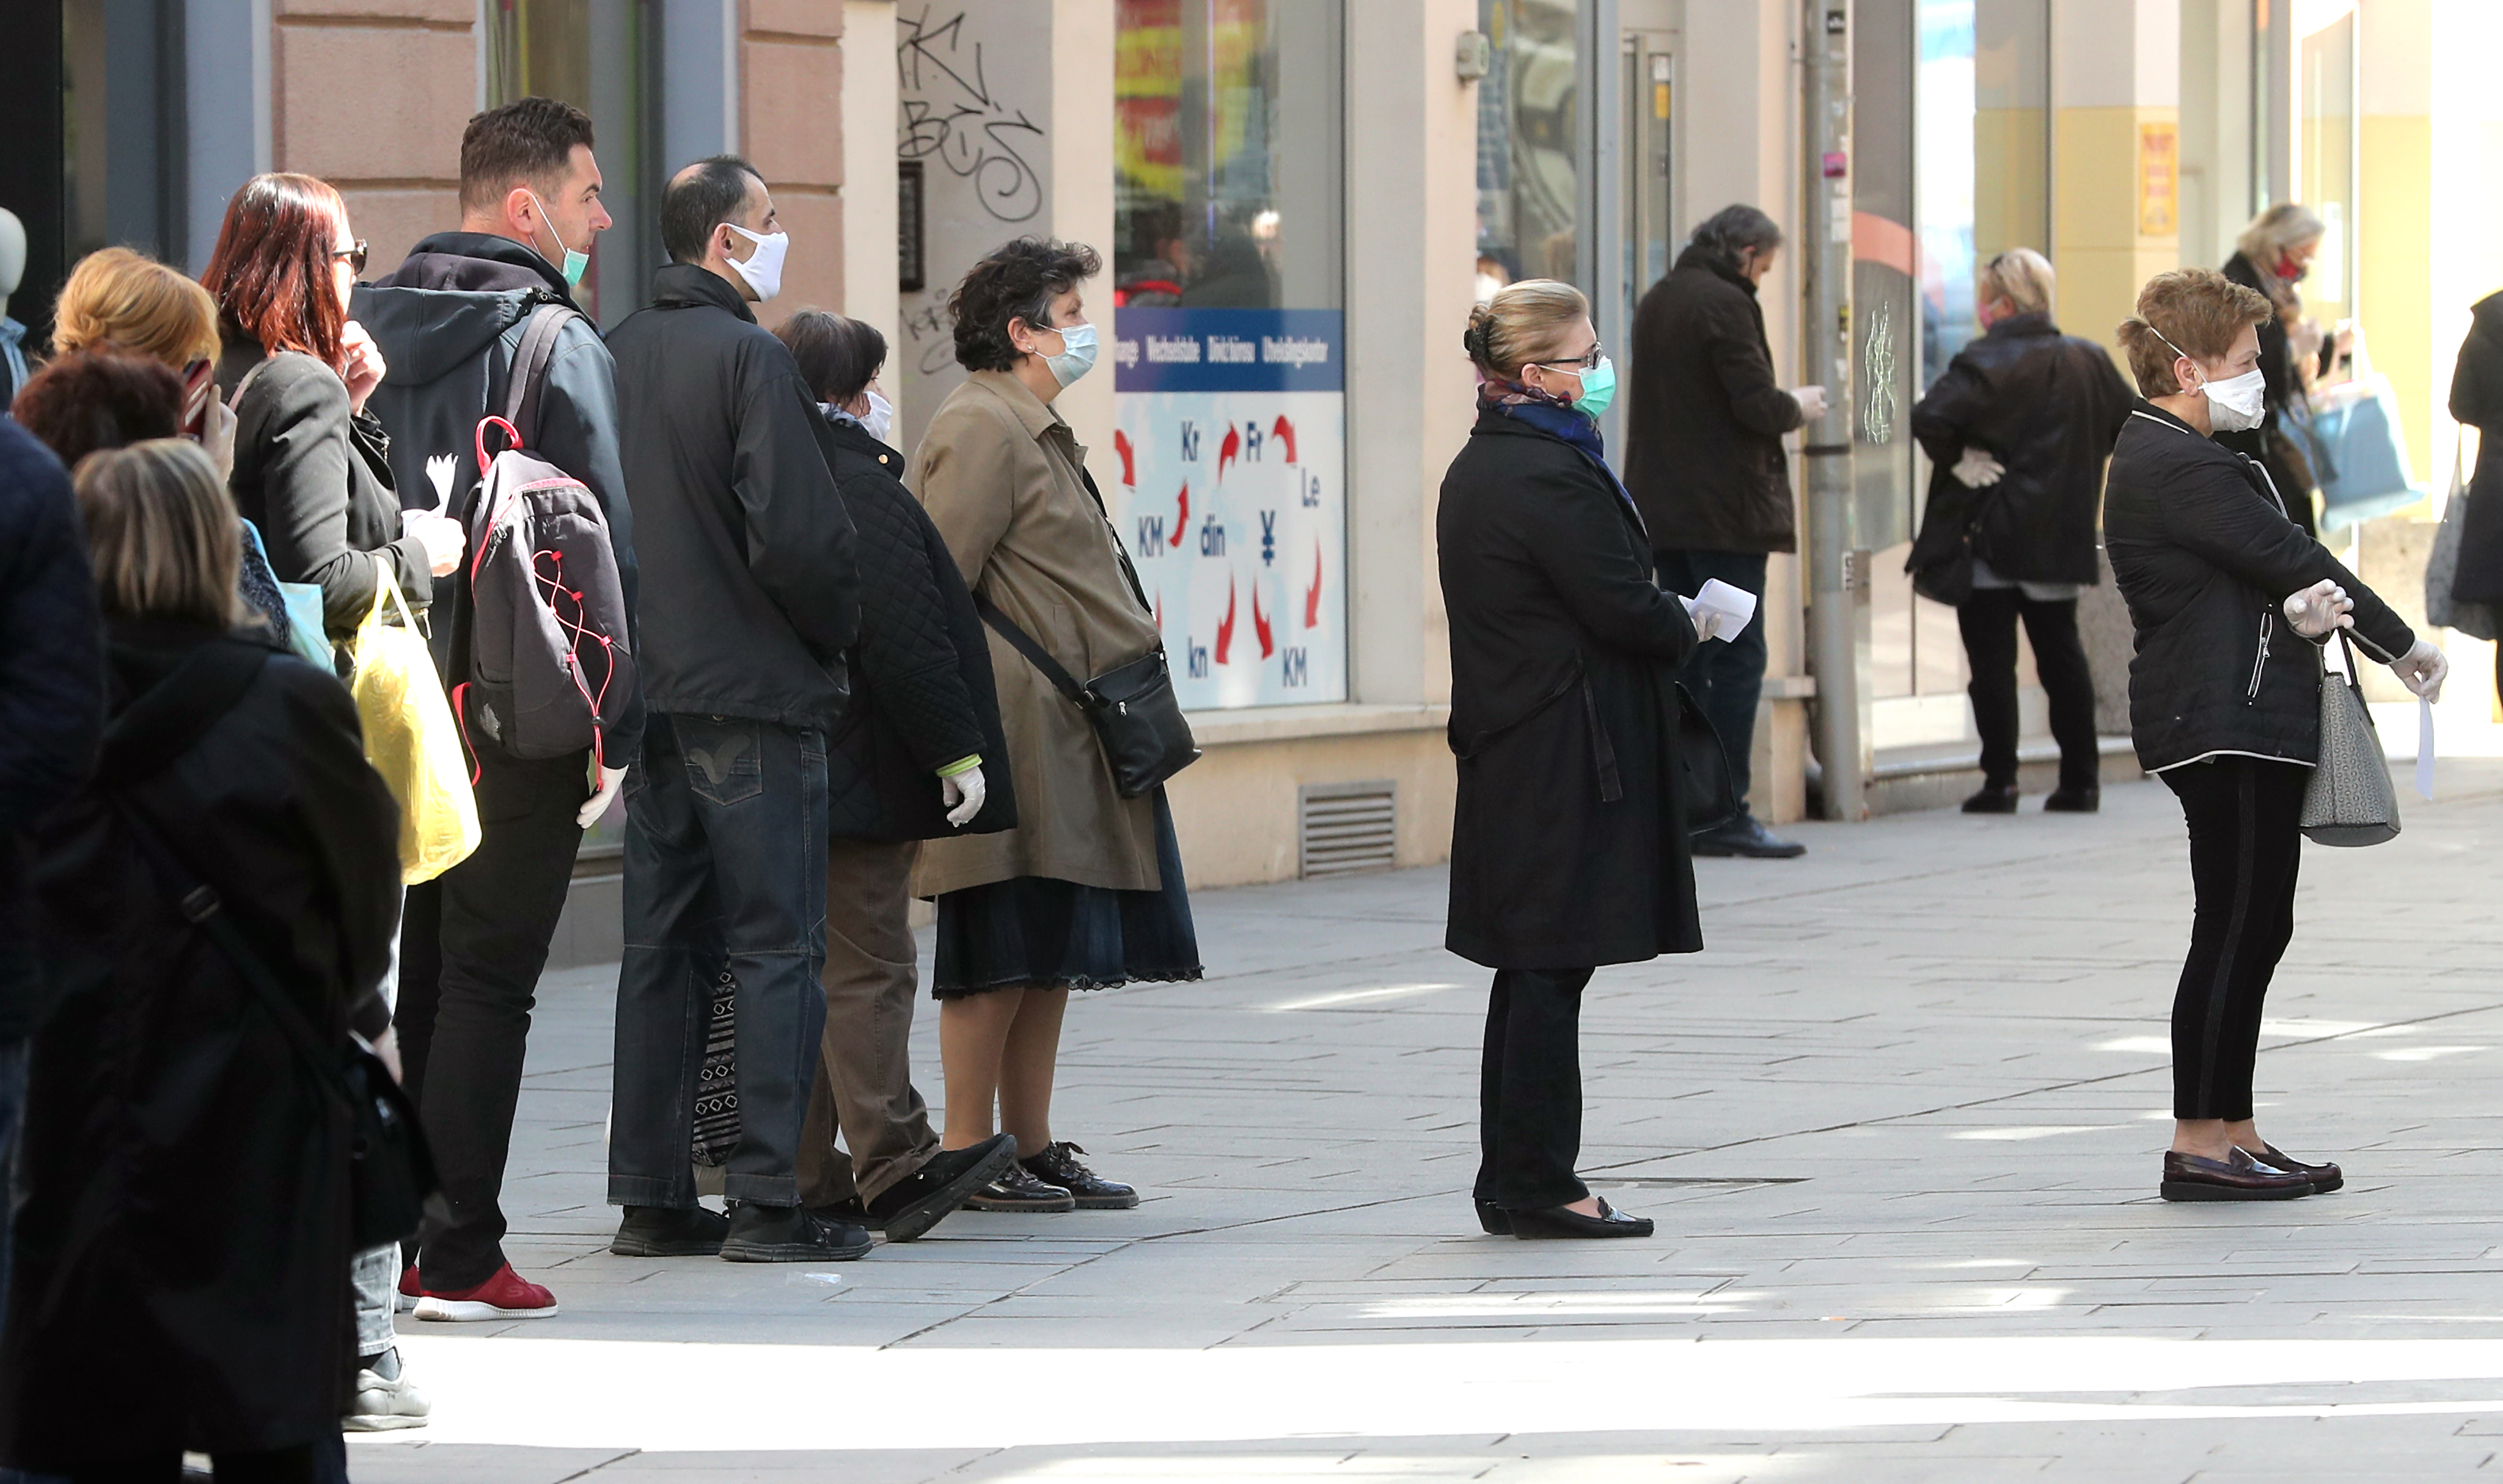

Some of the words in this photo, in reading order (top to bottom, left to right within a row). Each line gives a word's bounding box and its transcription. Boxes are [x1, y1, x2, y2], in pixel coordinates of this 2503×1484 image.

[1181, 420, 1200, 462] Kr
[1246, 421, 1263, 462] Fr
[1301, 467, 1320, 507] Le
[1138, 516, 1164, 557] KM
[1201, 514, 1225, 557] din
[1188, 635, 1208, 678] kn
[1283, 646, 1307, 687] KM
